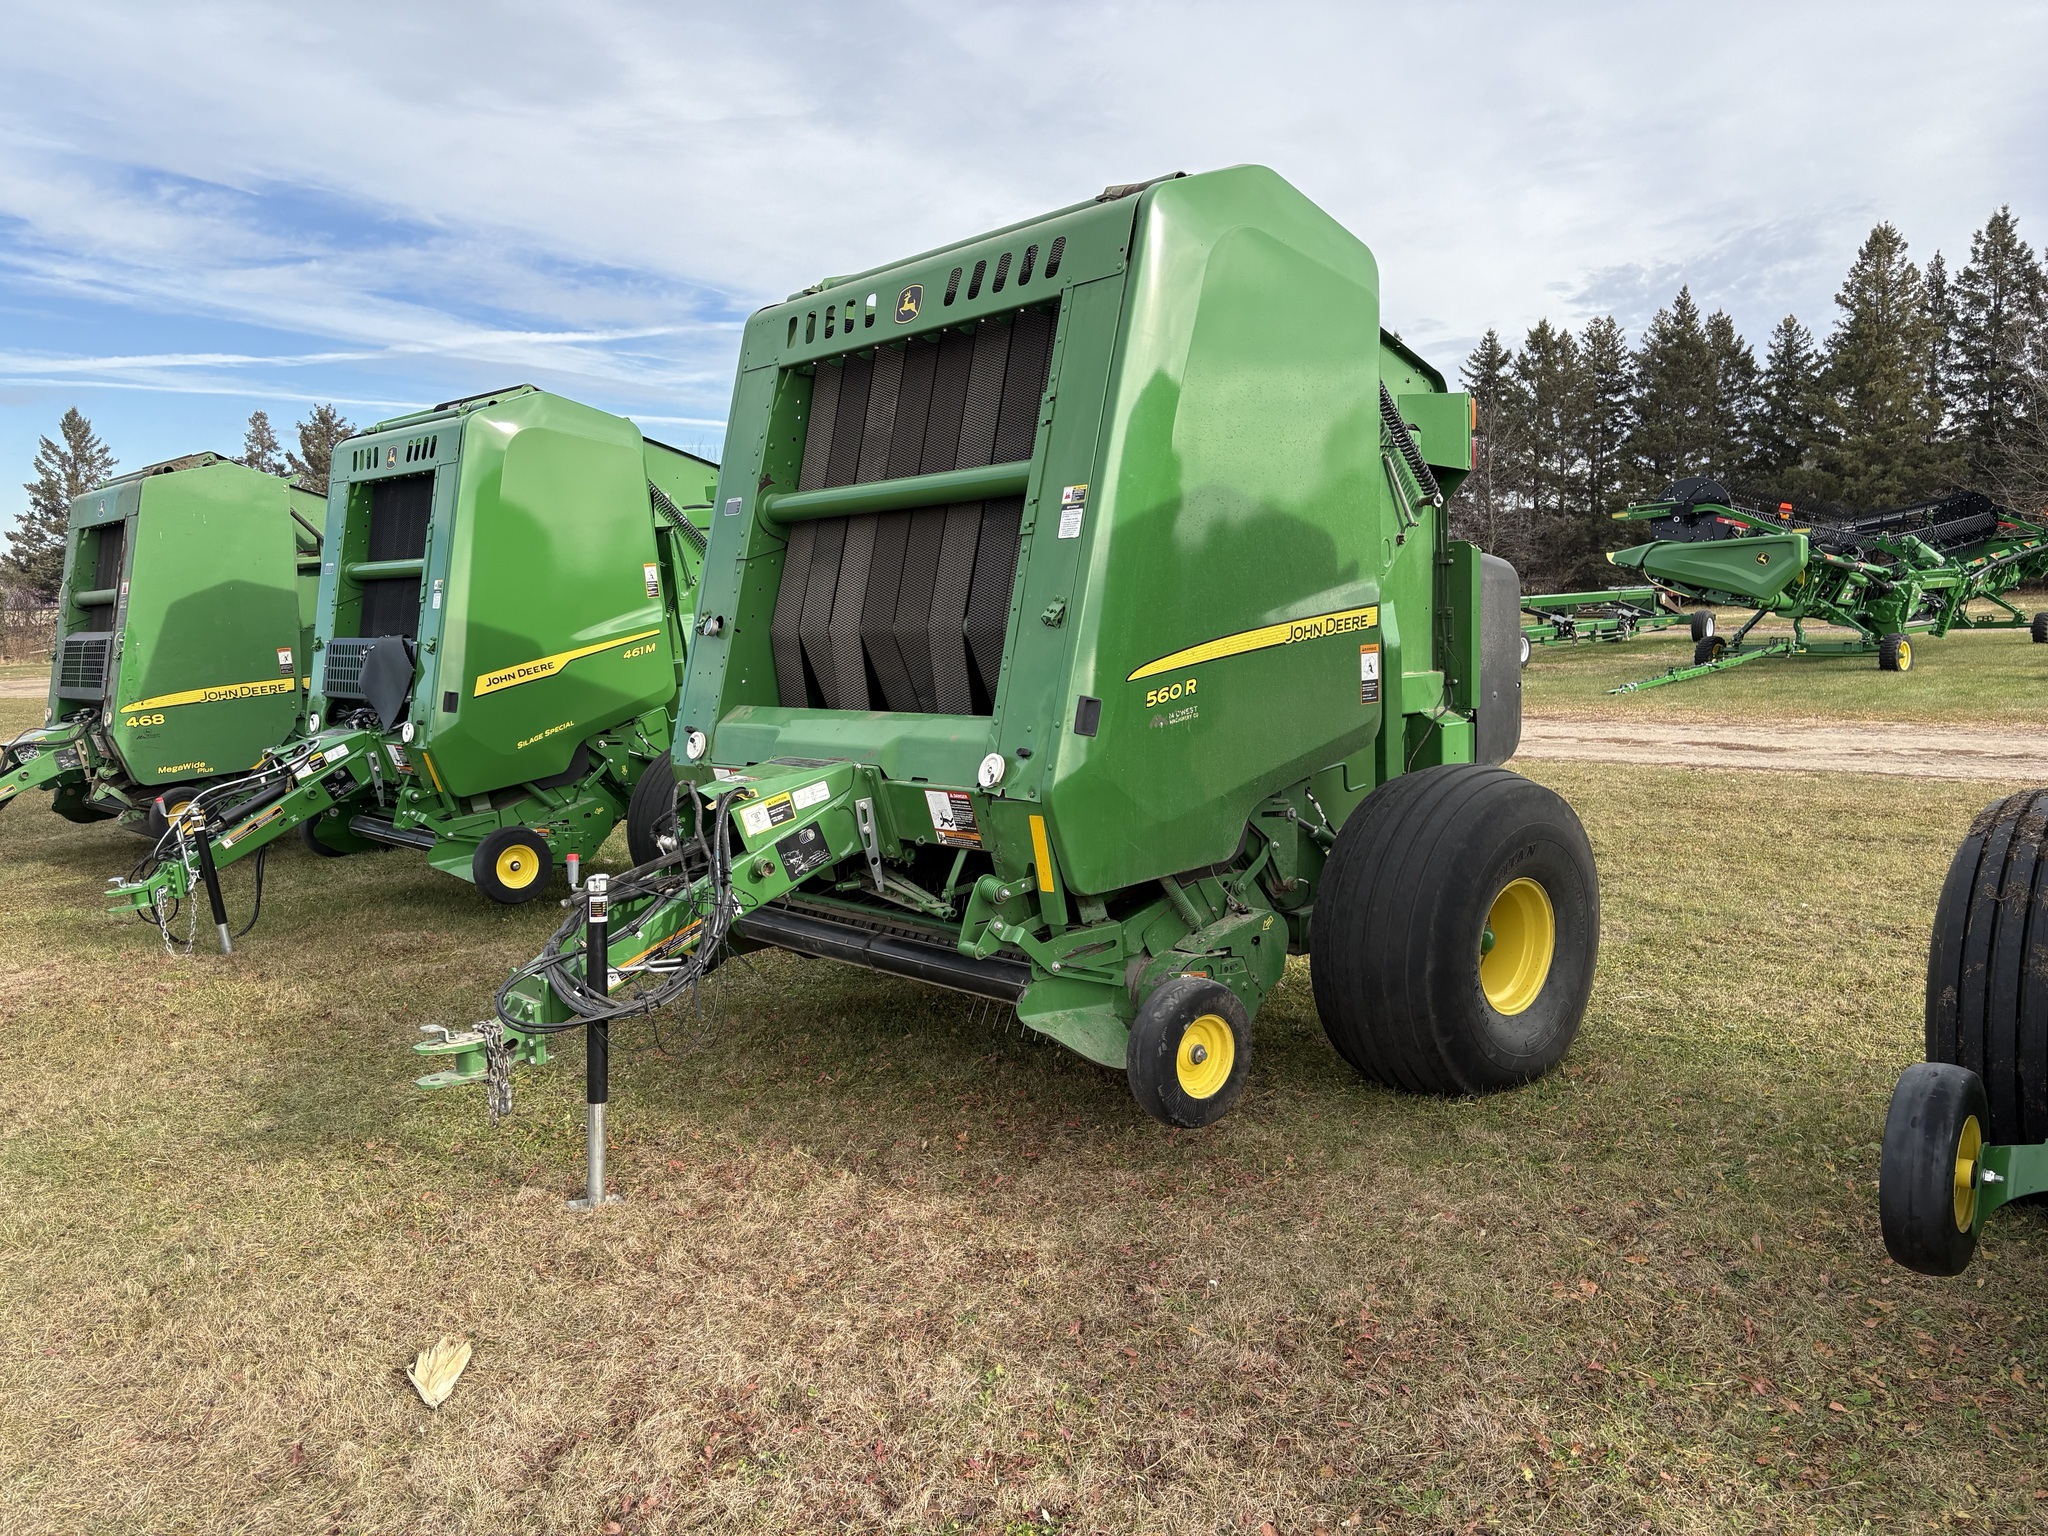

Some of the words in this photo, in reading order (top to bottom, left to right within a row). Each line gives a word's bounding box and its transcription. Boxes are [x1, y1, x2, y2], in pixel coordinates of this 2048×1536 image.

[1285, 622, 1322, 642] JOHN
[1325, 614, 1368, 635] DEERE
[622, 646, 644, 660] 461
[645, 642, 657, 654] M
[486, 672, 516, 687] JOHN
[517, 661, 555, 678] DEERE
[201, 688, 239, 702] JOHN
[240, 683, 286, 697] DEERE
[1145, 681, 1182, 708] 560
[1184, 677, 1198, 697] R
[125, 713, 166, 728] 468
[517, 733, 544, 749] SILAGE
[544, 720, 575, 737] SPECIAL
[157, 761, 206, 775] MegaWide
[196, 766, 214, 774] Plus
